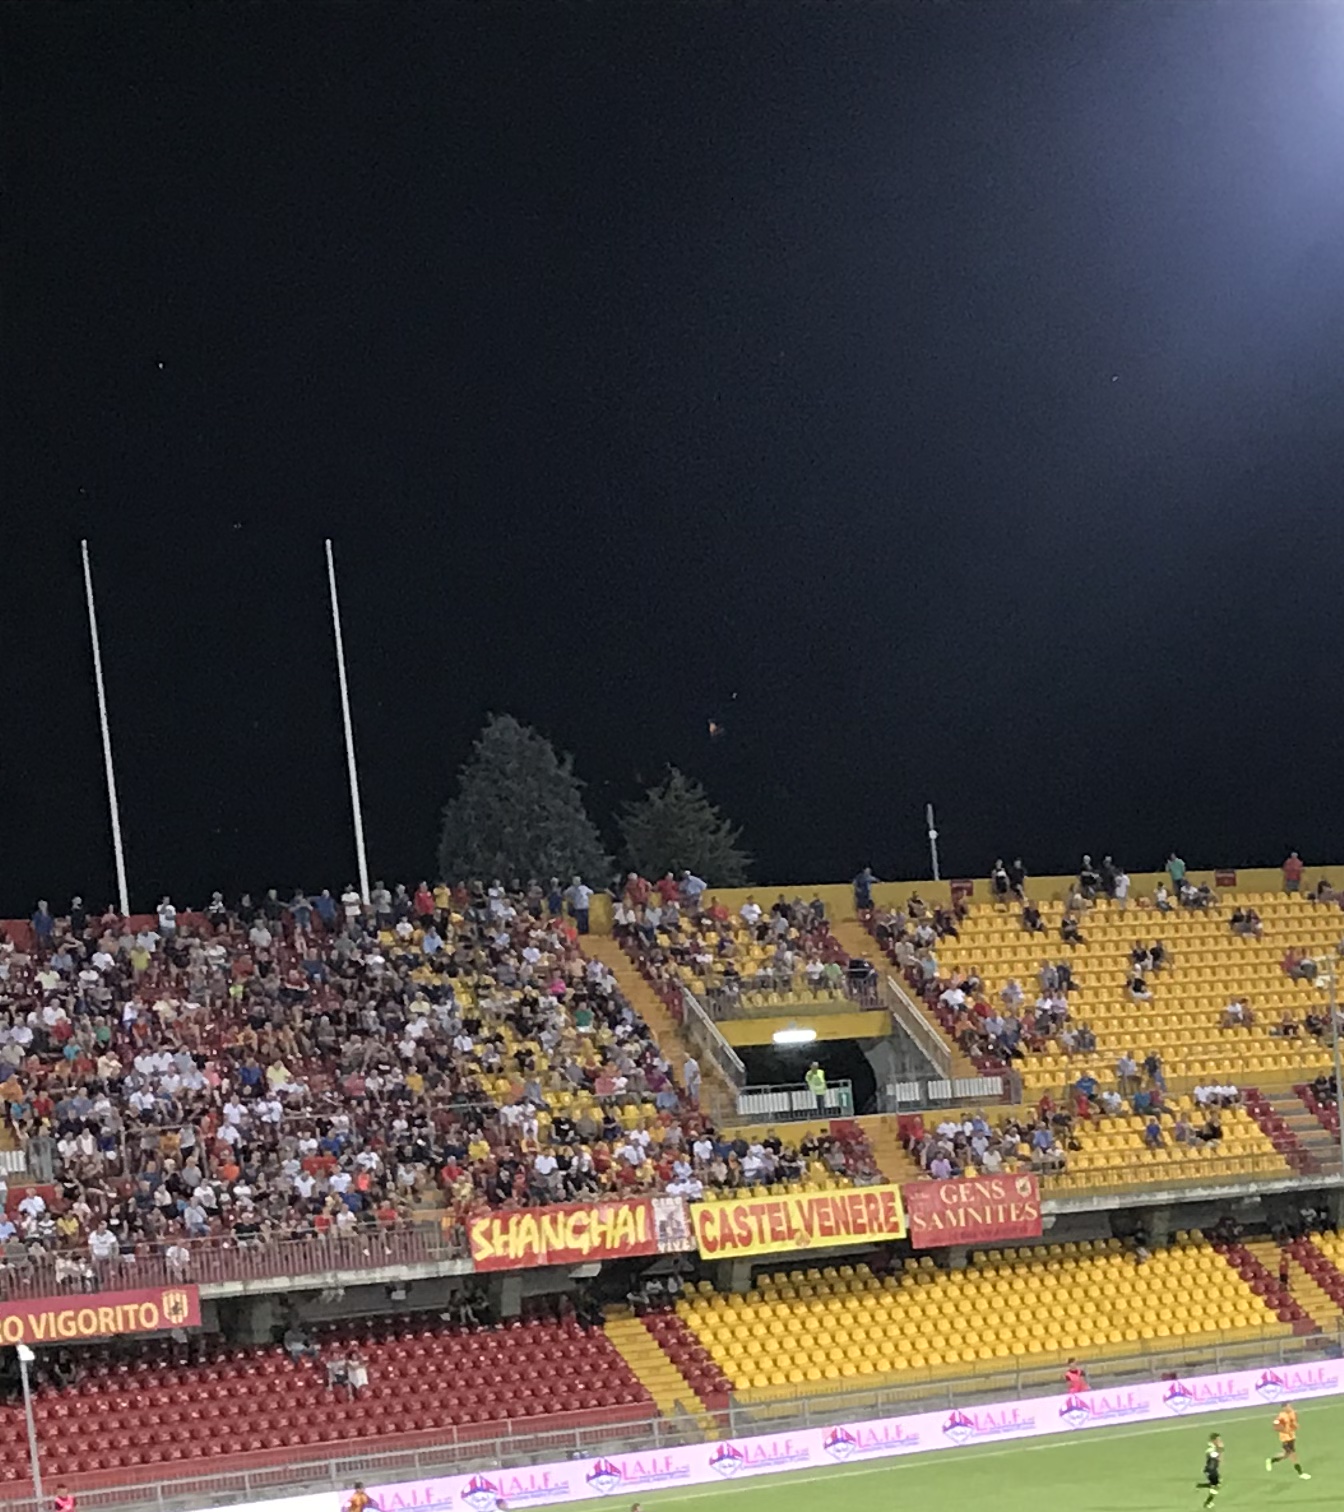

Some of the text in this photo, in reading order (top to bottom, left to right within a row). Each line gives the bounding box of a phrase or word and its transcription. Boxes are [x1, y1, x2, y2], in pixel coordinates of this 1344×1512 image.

[939, 1180, 1006, 1206] GENS
[469, 1204, 648, 1261] SHANGHAI
[912, 1201, 1039, 1232] SAMNITES
[28, 1302, 159, 1340] VIGORITO
